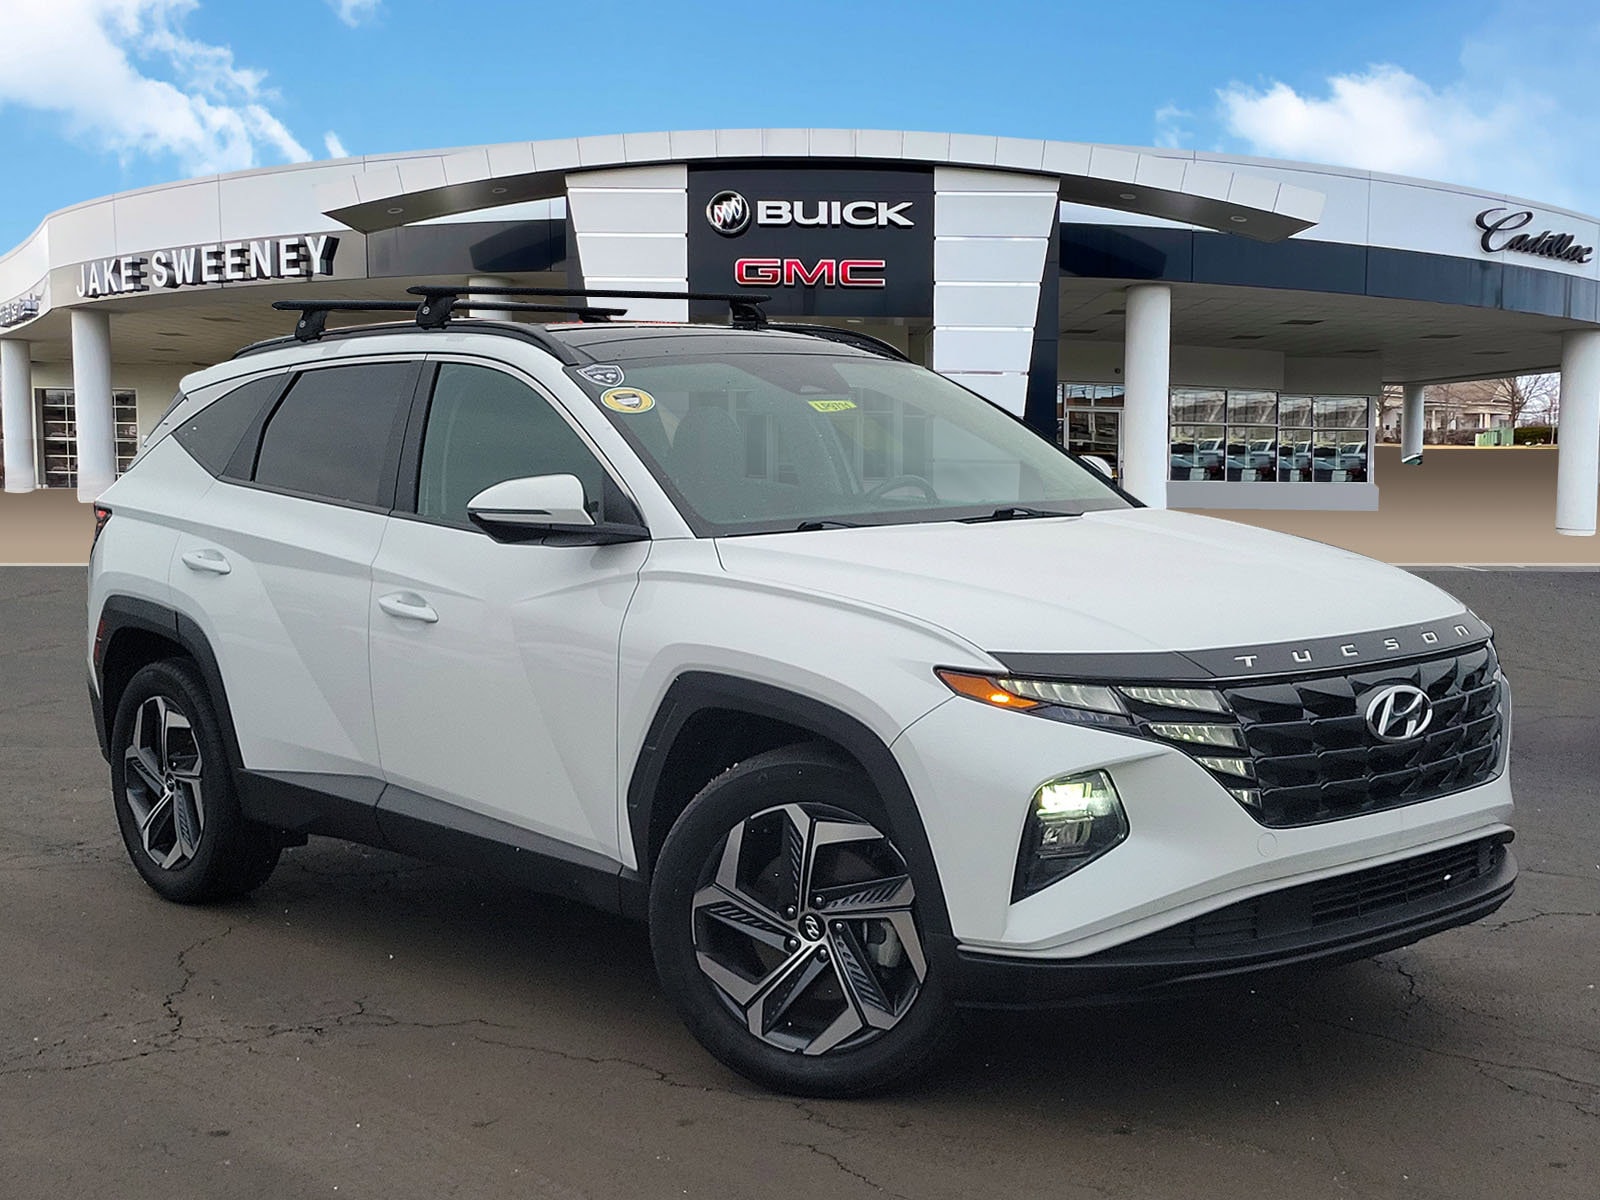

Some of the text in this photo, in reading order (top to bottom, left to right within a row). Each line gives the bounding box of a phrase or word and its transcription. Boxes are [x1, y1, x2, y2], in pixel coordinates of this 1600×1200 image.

[757, 200, 915, 226] BUICK
[1475, 207, 1593, 264] Cadillac
[76, 234, 335, 298] JAKE SWEENEY
[734, 258, 886, 287] GMC
[1234, 625, 1471, 668] TUCSON
